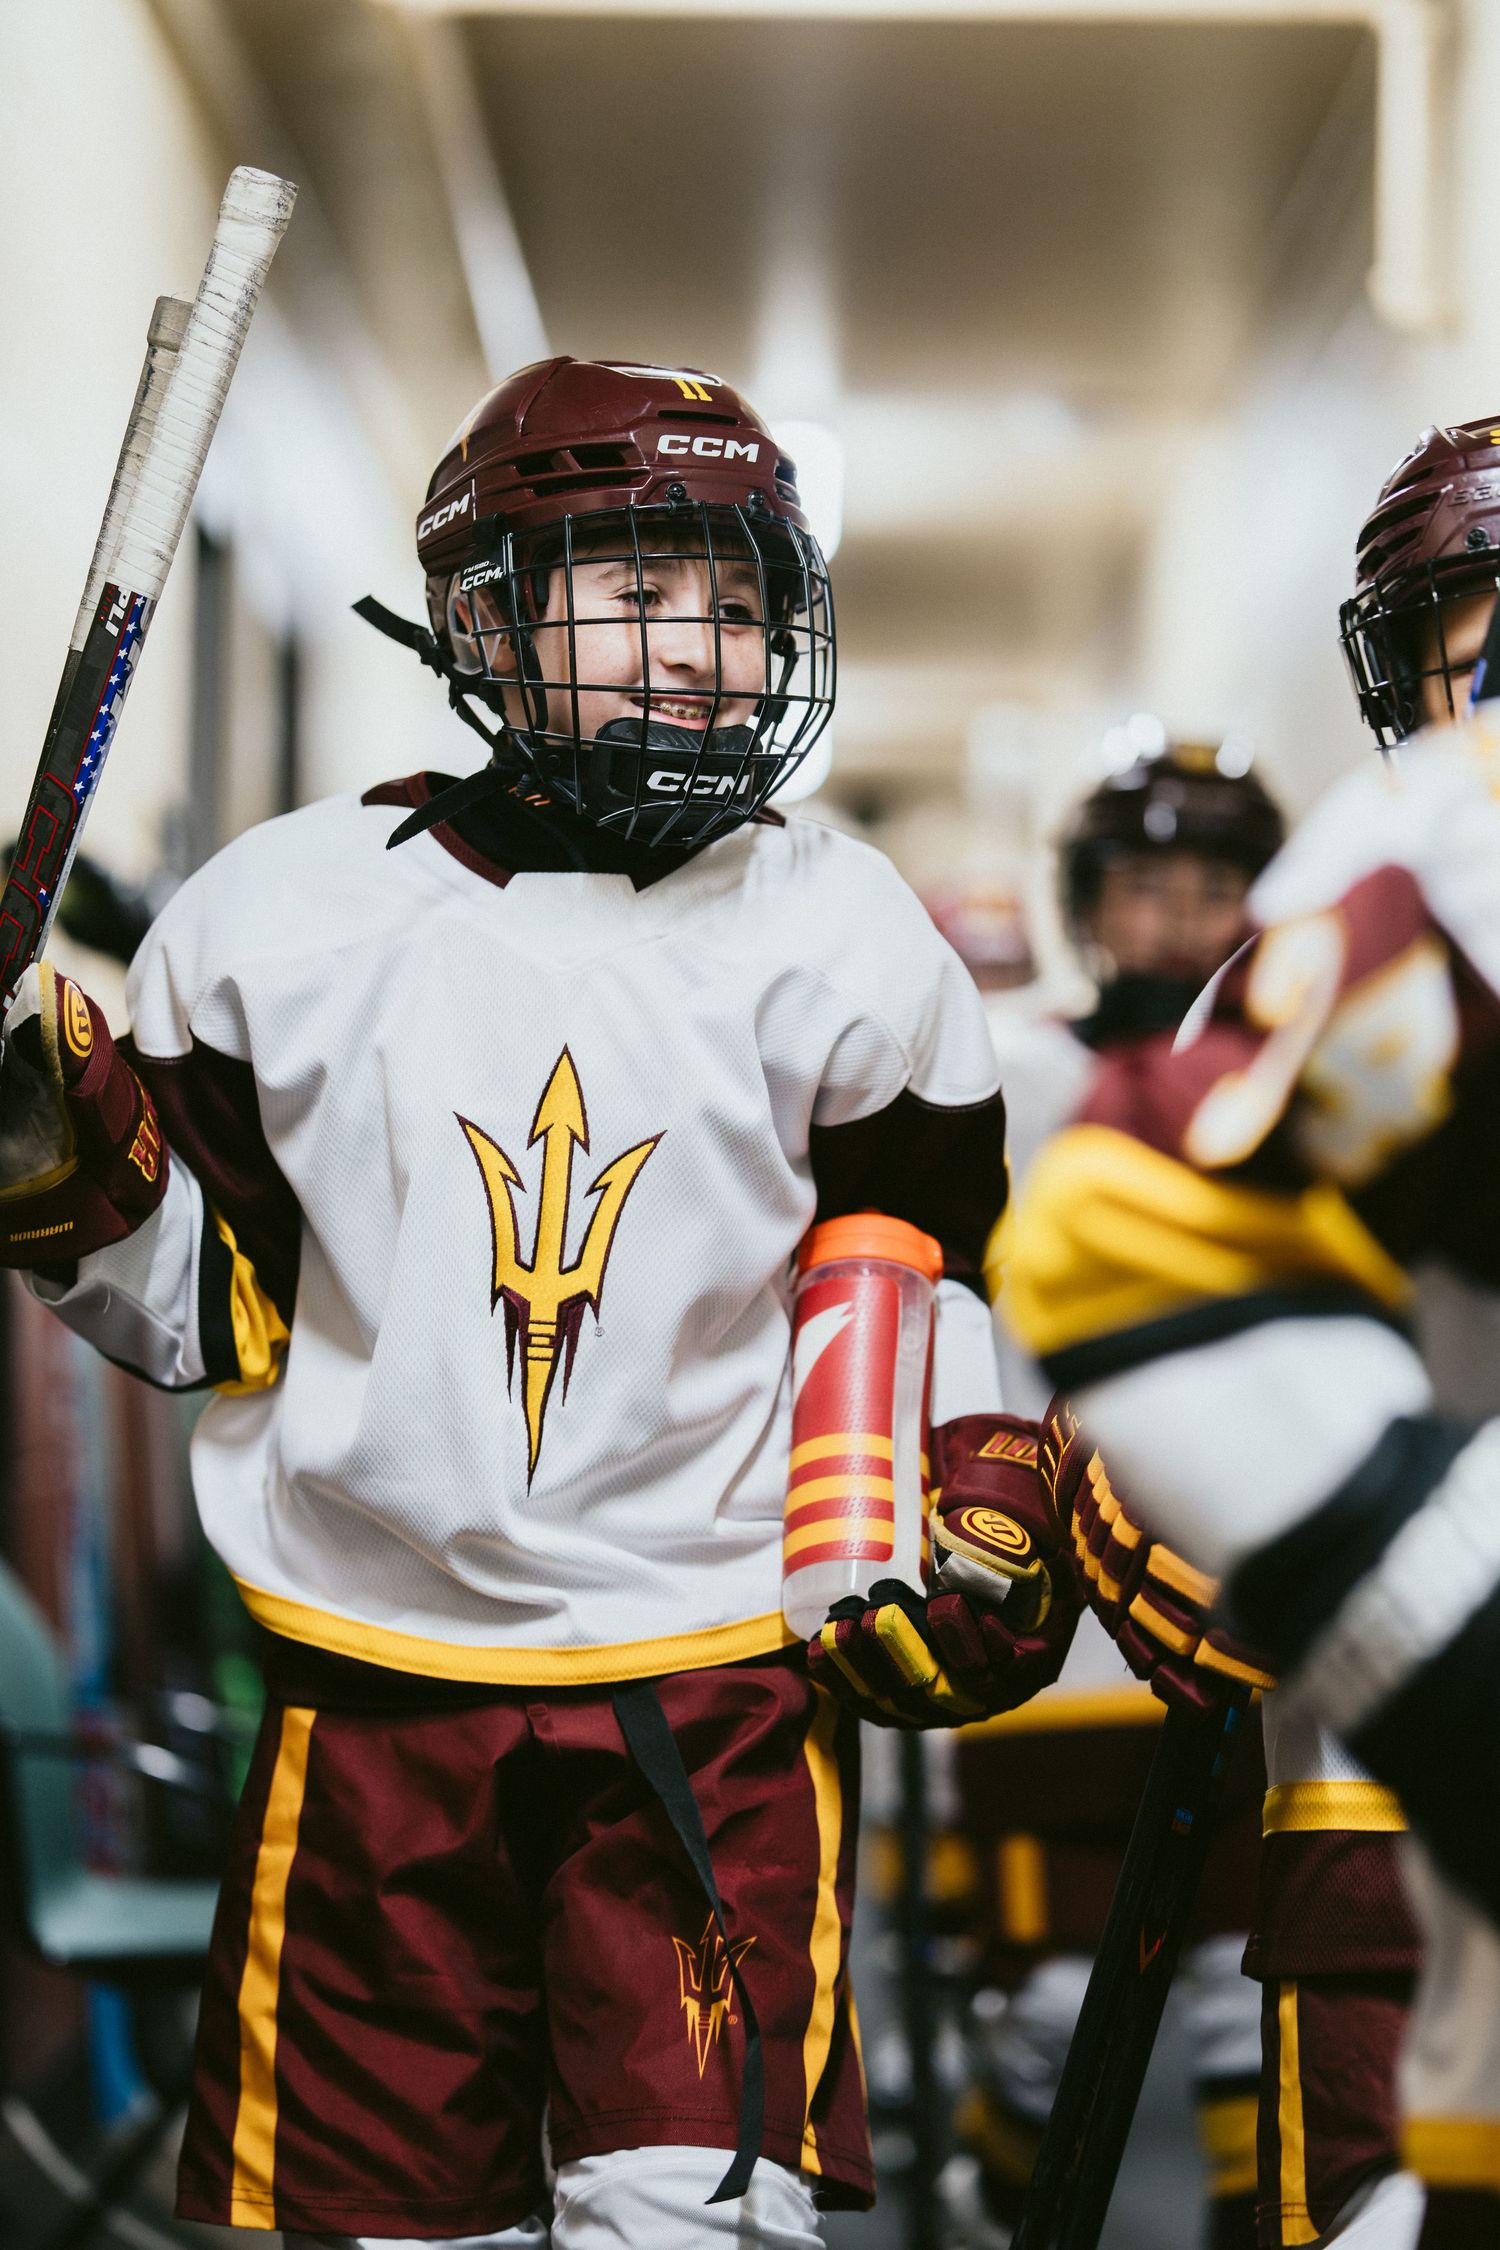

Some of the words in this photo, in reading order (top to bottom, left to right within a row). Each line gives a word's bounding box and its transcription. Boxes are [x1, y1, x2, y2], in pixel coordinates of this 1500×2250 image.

[657, 434, 760, 463] CCM
[417, 493, 470, 541] CCM
[460, 566, 503, 592] CCM
[646, 770, 750, 795] CCM
